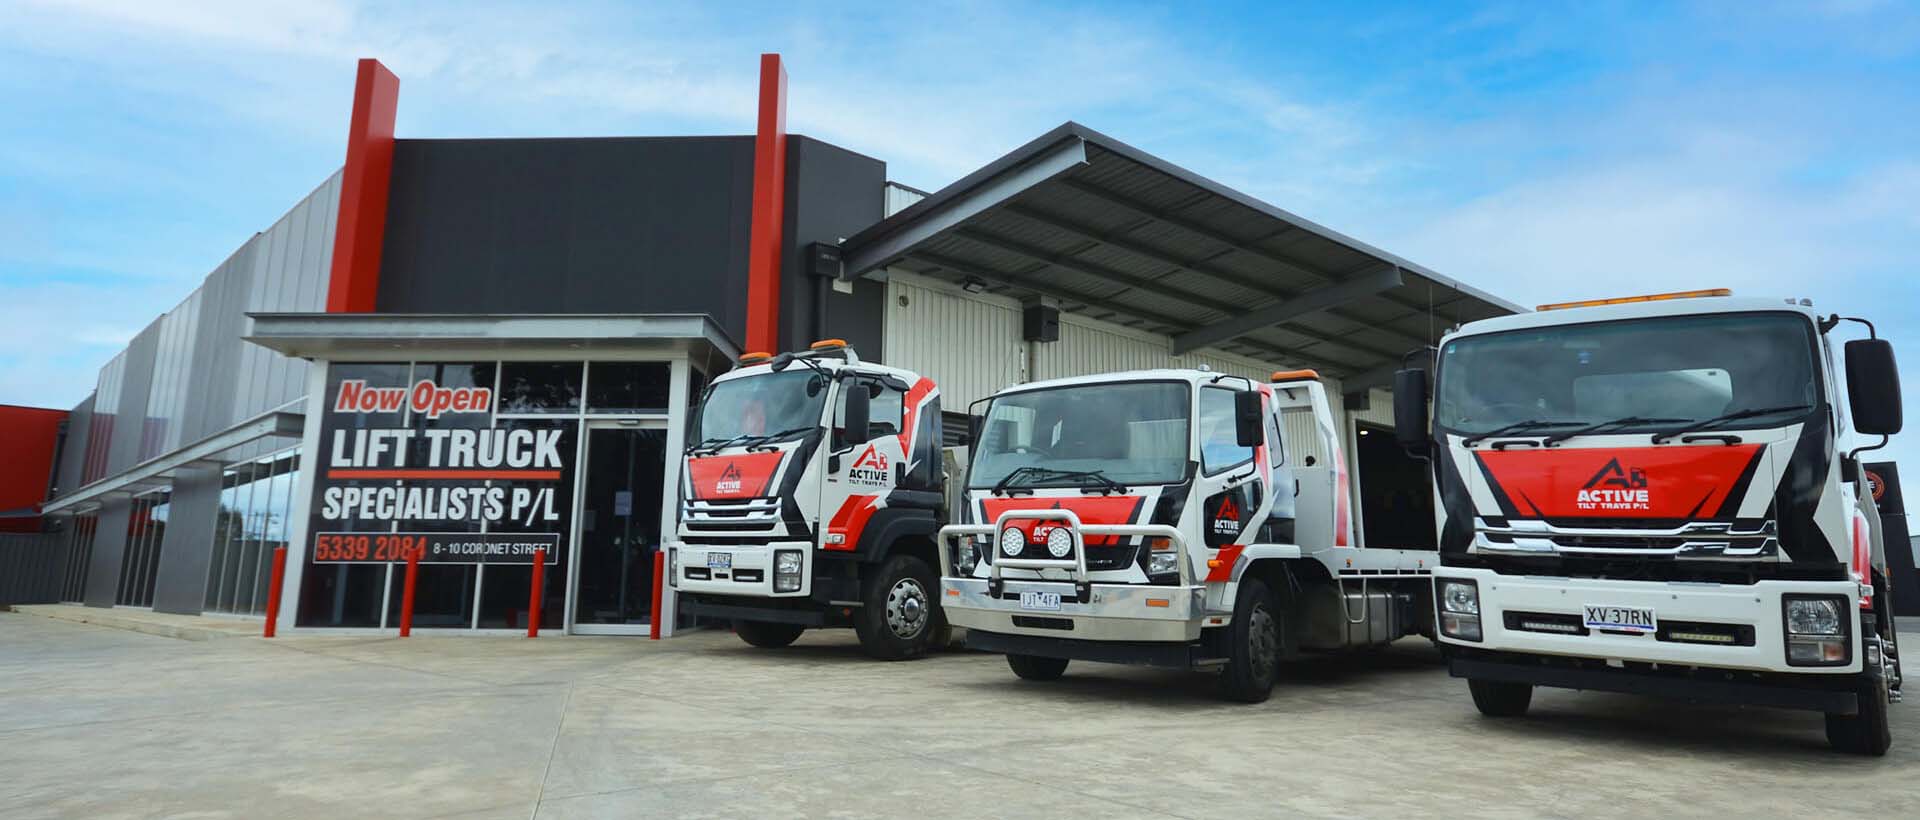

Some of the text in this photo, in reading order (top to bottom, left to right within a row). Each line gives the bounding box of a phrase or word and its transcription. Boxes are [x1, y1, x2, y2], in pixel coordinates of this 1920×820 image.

[335, 379, 491, 418] Now Open
[331, 429, 562, 468] LIFT TRUCK
[848, 469, 888, 481] ACTIVE
[716, 481, 741, 489] ACTIVE
[1577, 489, 1649, 502] ACTIVE
[322, 486, 559, 527] SPECIALISTS P/L
[1577, 502, 1650, 510] TILT TRAYS P/L
[1214, 519, 1239, 530] ACTIVE
[317, 536, 369, 561] 5339
[373, 536, 428, 561] 2084
[461, 542, 510, 555] CORONET
[511, 542, 553, 556] STREET
